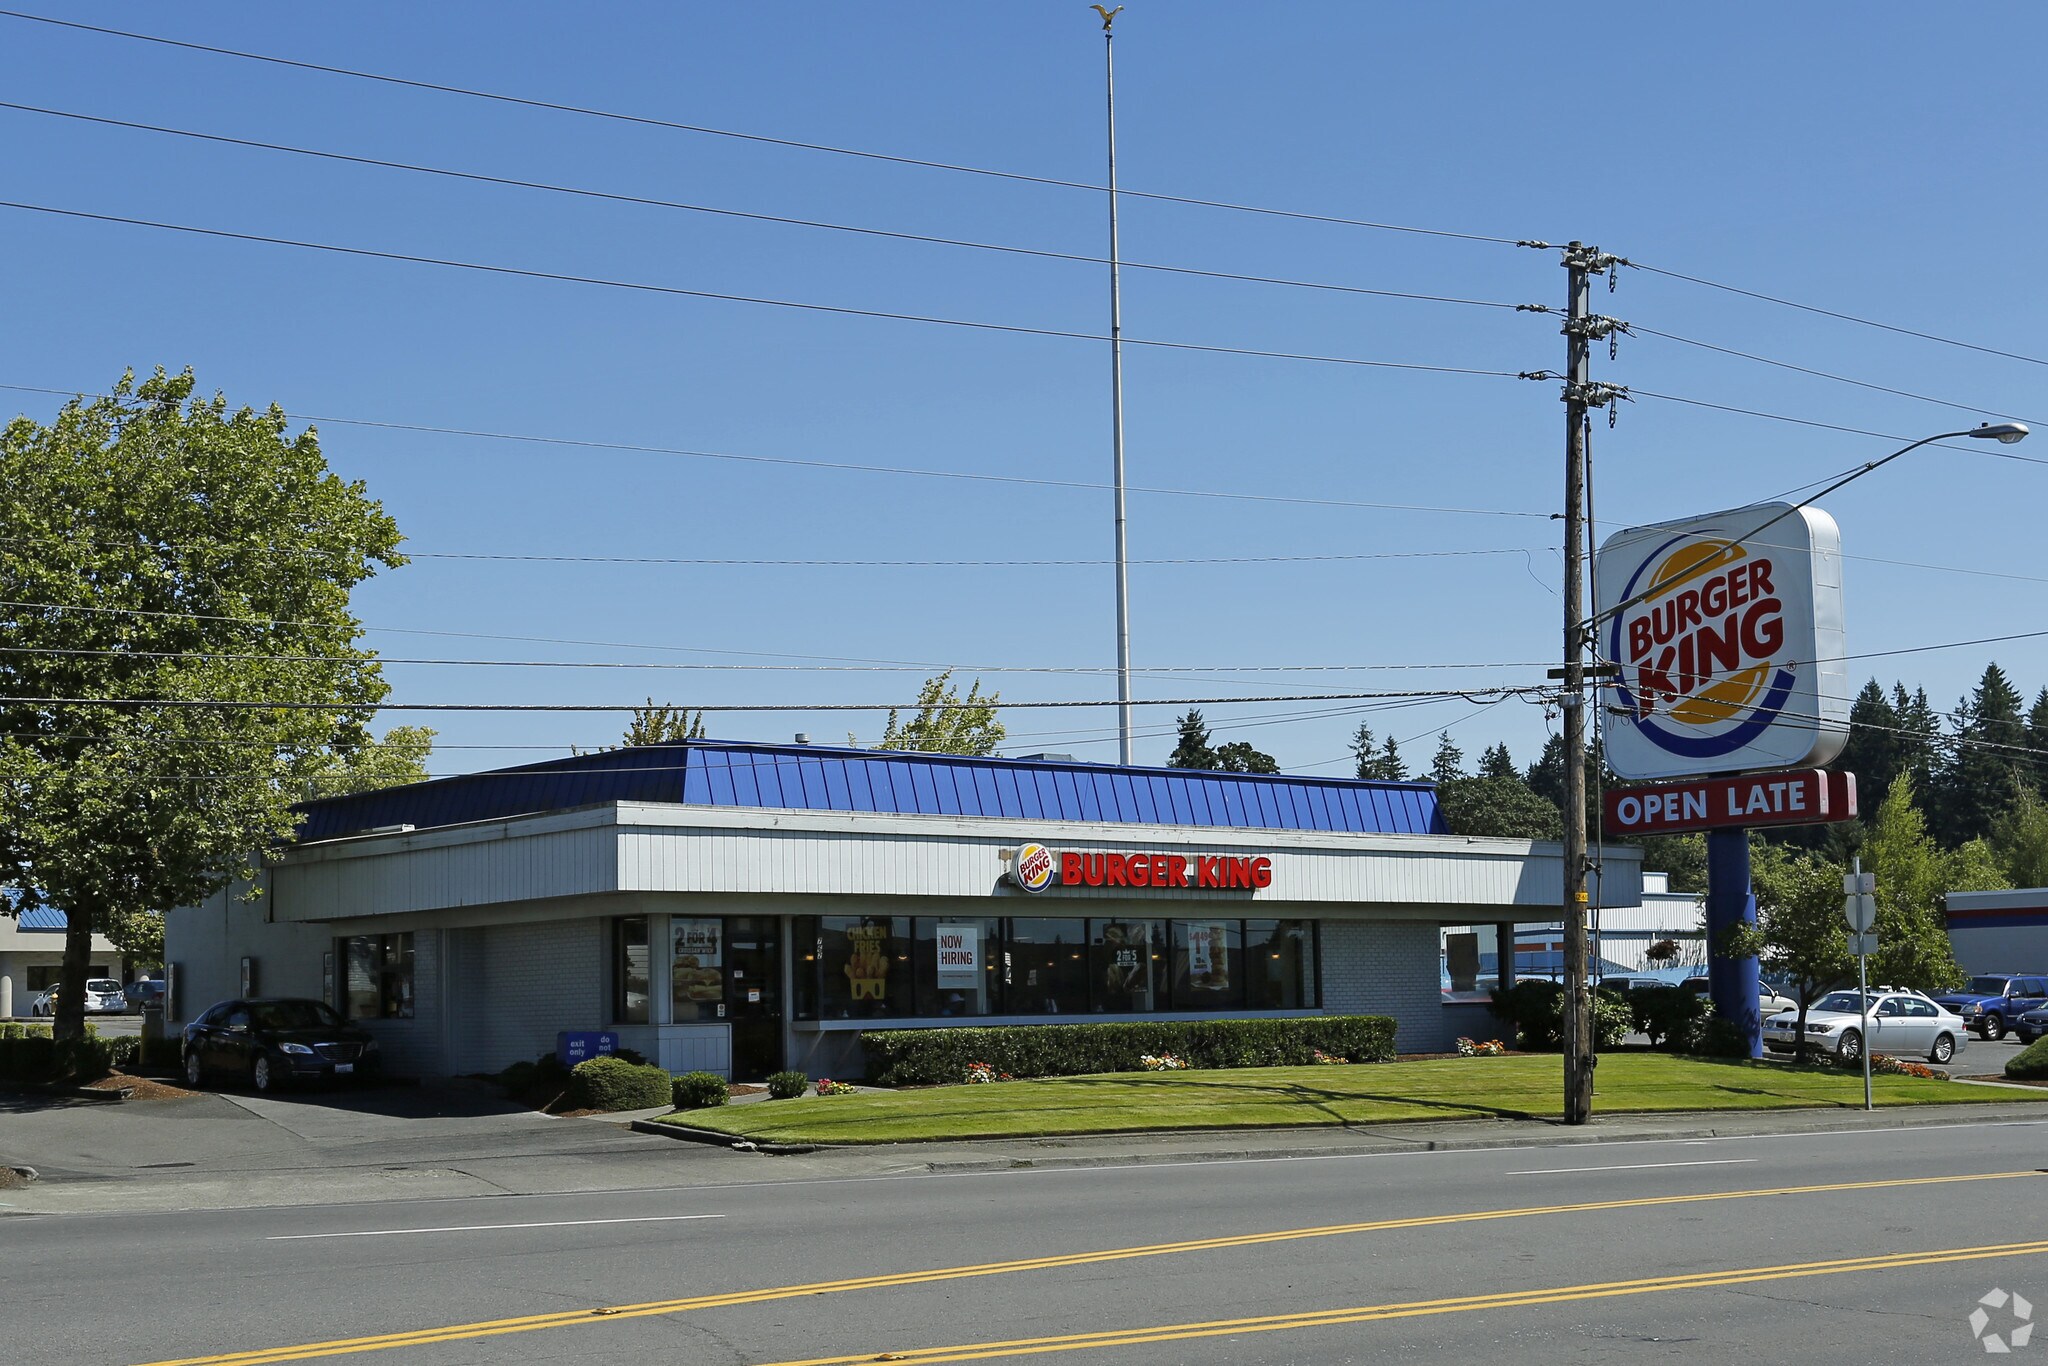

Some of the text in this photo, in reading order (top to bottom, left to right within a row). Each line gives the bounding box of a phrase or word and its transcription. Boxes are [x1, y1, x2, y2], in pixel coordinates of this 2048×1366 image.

[1628, 558, 1775, 663] BURGER
[1638, 598, 1784, 723] KING
[1617, 780, 1805, 825] OPEN LATE
[1020, 848, 1047, 874] BURGER
[1023, 856, 1050, 885] KING
[1061, 852, 1272, 889] BURGER KING
[675, 927, 685, 946] 2
[687, 932, 705, 944] FOR
[847, 926, 887, 941] CHICKEN
[941, 935, 962, 948] NOW
[854, 940, 881, 952] FRIES
[1116, 950, 1122, 961] 2
[941, 951, 972, 965] HIRING
[569, 1049, 585, 1057] only
